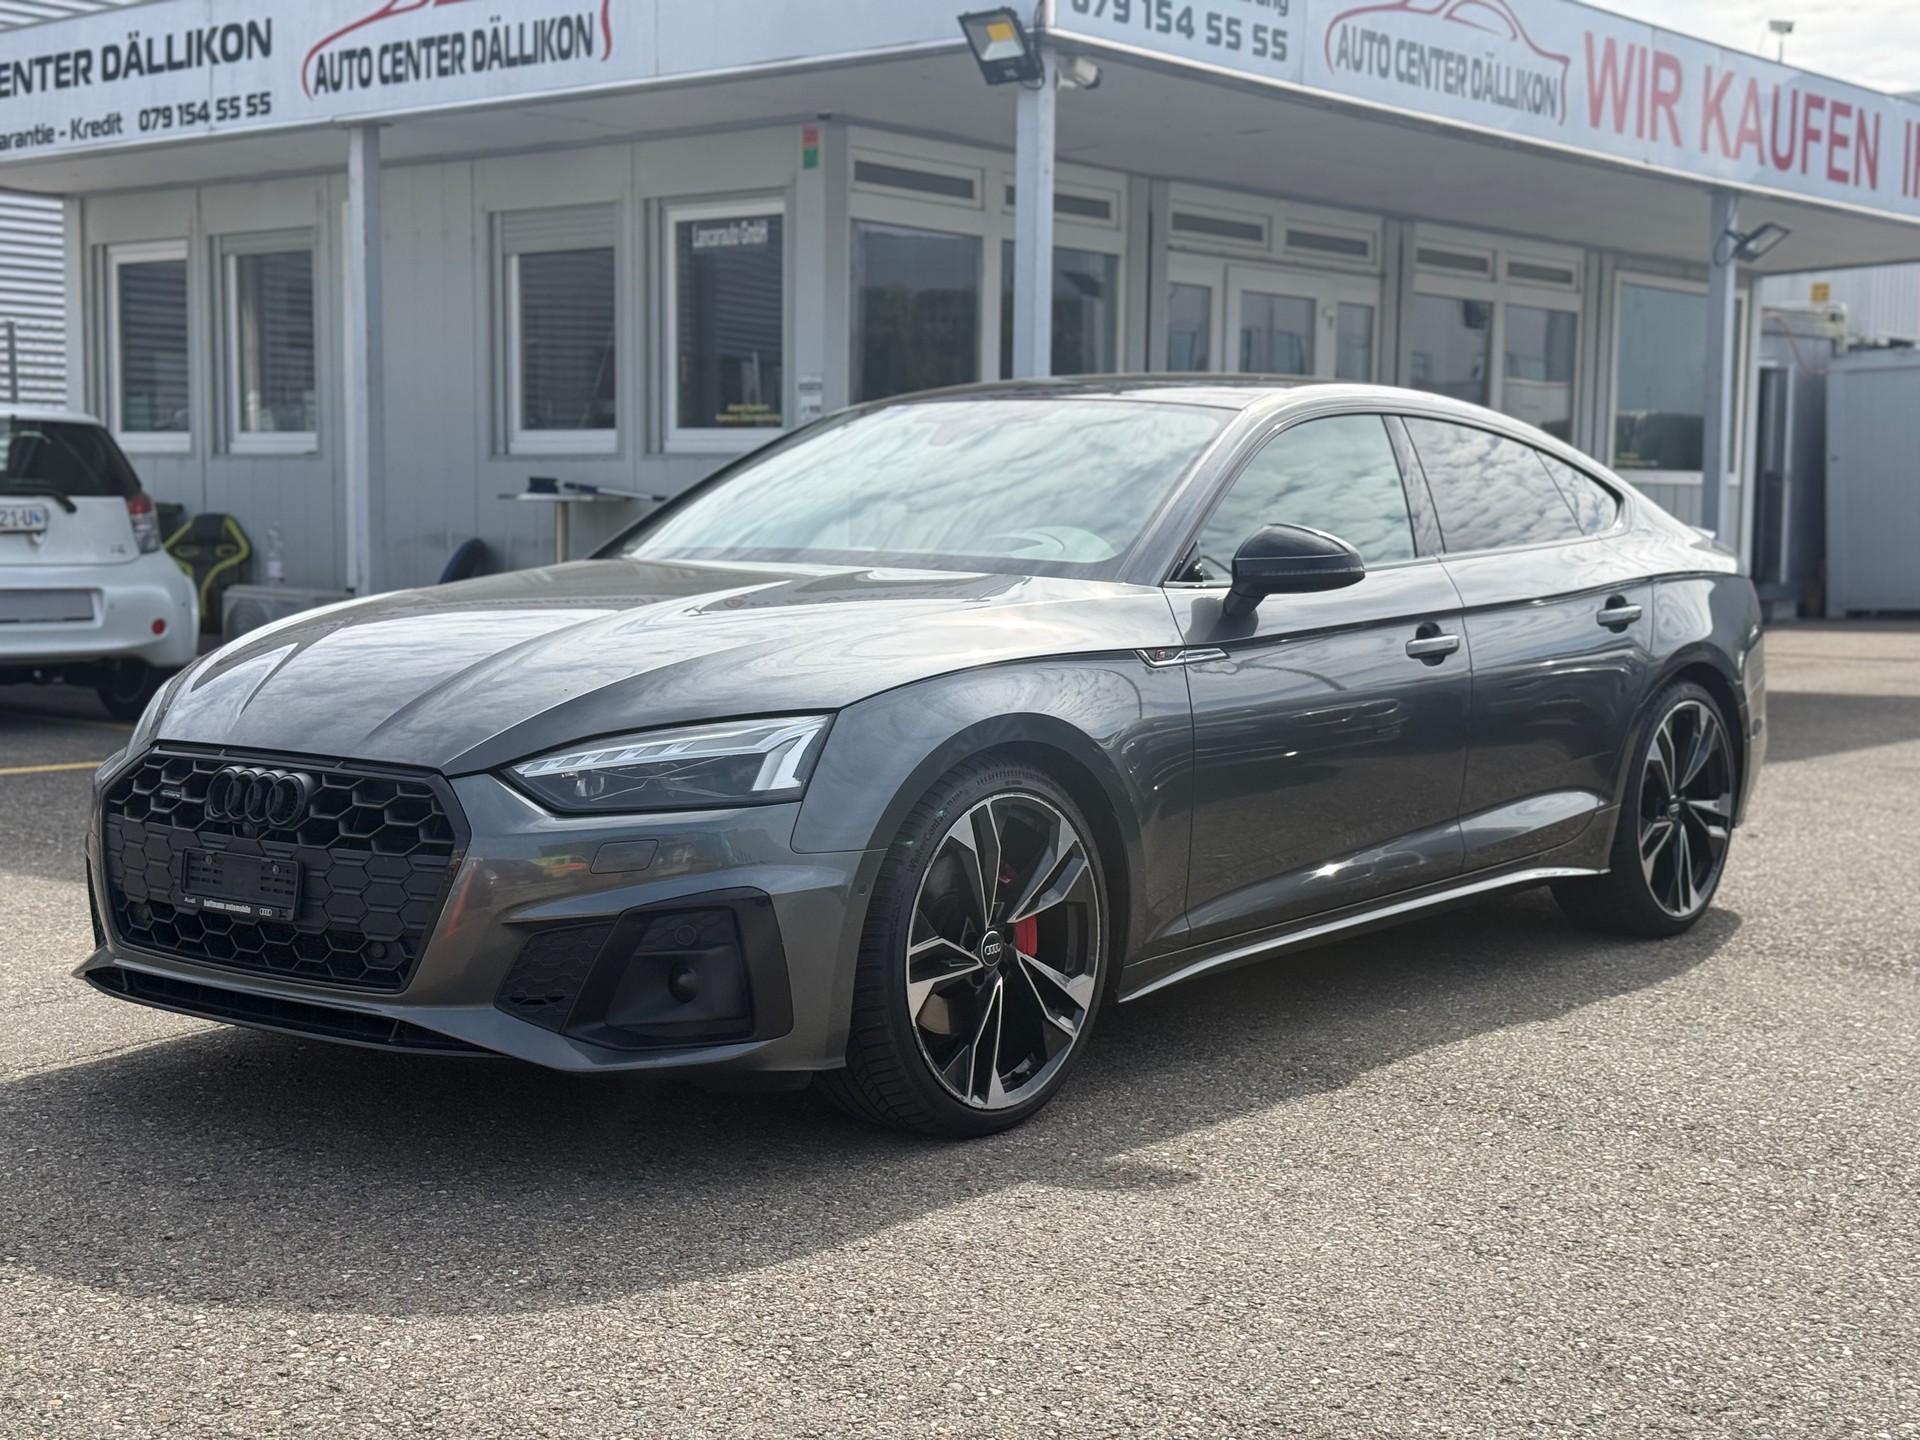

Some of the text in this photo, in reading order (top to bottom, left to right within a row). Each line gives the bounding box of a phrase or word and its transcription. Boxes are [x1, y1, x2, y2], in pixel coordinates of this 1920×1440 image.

[102, 18, 272, 82] DÄLLIKON
[314, 12, 594, 96] AUTO CENTER DÄLLIKON
[1206, 12, 1242, 51] 55
[1253, 24, 1288, 62] 55
[1336, 23, 1557, 119] AUTO CENTER DÄLLIKON
[70, 112, 123, 141] Kredit
[138, 106, 172, 132] 079
[177, 102, 210, 126] 154
[216, 97, 241, 121] 55
[246, 92, 271, 117] 55
[1584, 31, 1682, 148] WIR
[1700, 64, 1881, 191] KAUFEN
